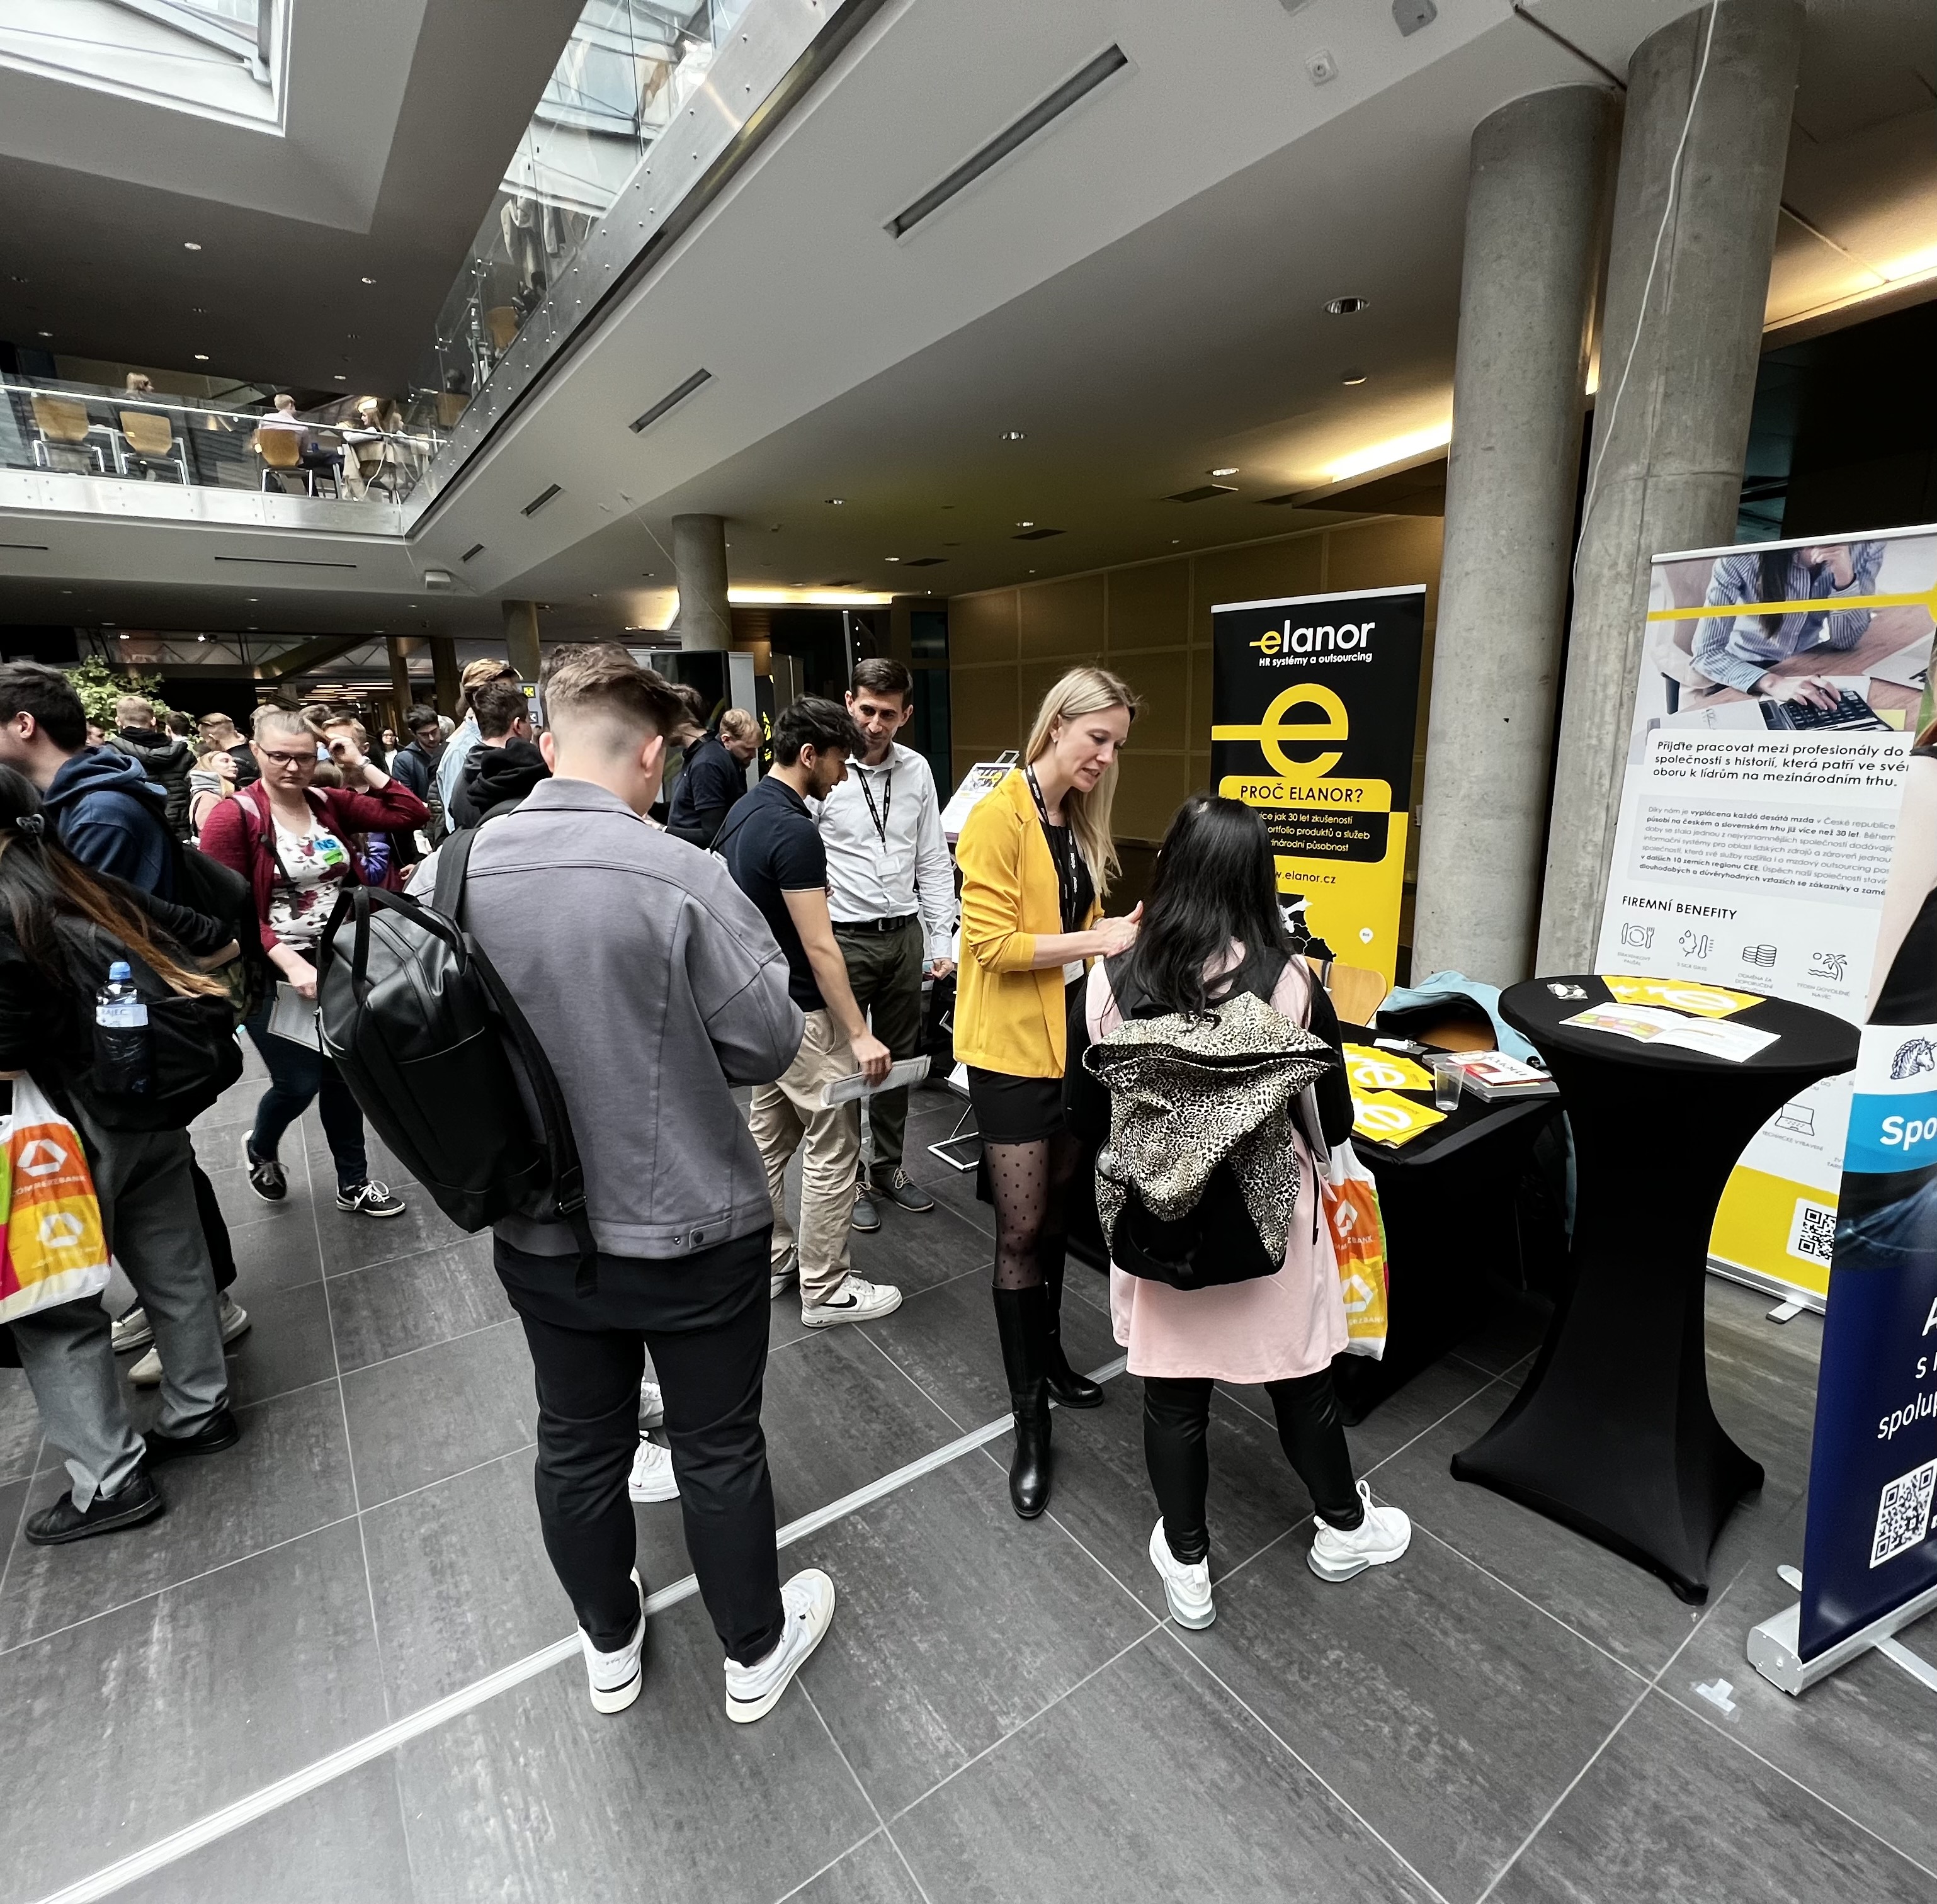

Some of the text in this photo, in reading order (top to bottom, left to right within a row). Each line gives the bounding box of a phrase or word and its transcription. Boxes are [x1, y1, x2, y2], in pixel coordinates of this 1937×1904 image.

[1249, 620, 1375, 655] elanor
[1259, 657, 1270, 667] HR
[1272, 655, 1308, 667] systémy
[1319, 652, 1373, 664] outsourcing
[1657, 740, 1693, 752] Přijďte
[1696, 743, 1754, 753] pracovat
[1758, 744, 1789, 753] mezi
[1792, 744, 1880, 758] profesionály
[1883, 746, 1904, 756] do
[1655, 754, 1722, 765] společnosti
[1734, 757, 1778, 768] historií,
[1783, 757, 1818, 769] která
[1822, 759, 1855, 771] patří
[1858, 762, 1875, 771] ve
[1653, 768, 1686, 777] oboru
[1690, 769, 1696, 778] k
[1700, 768, 1738, 779] lídrům
[1763, 771, 1861, 785] mezinárodním
[1865, 775, 1897, 787] trhu.
[1241, 783, 1363, 803] PROČ ELANOR?
[1274, 812, 1287, 822] jak
[1288, 813, 1298, 821] 30
[1299, 813, 1310, 822] let
[1683, 818, 1712, 826] českém
[1691, 810, 1731, 818] vyplácena
[1733, 812, 1758, 820] každá
[1824, 817, 1850, 826] České
[1268, 825, 1295, 835] ortfolio
[1297, 827, 1334, 837] produktů
[1344, 830, 1370, 840] služeb
[1306, 840, 1349, 852] působnost
[1276, 870, 1336, 884] w.elanor.cz
[1622, 895, 1737, 920] FIREMNÍ BENEFITY
